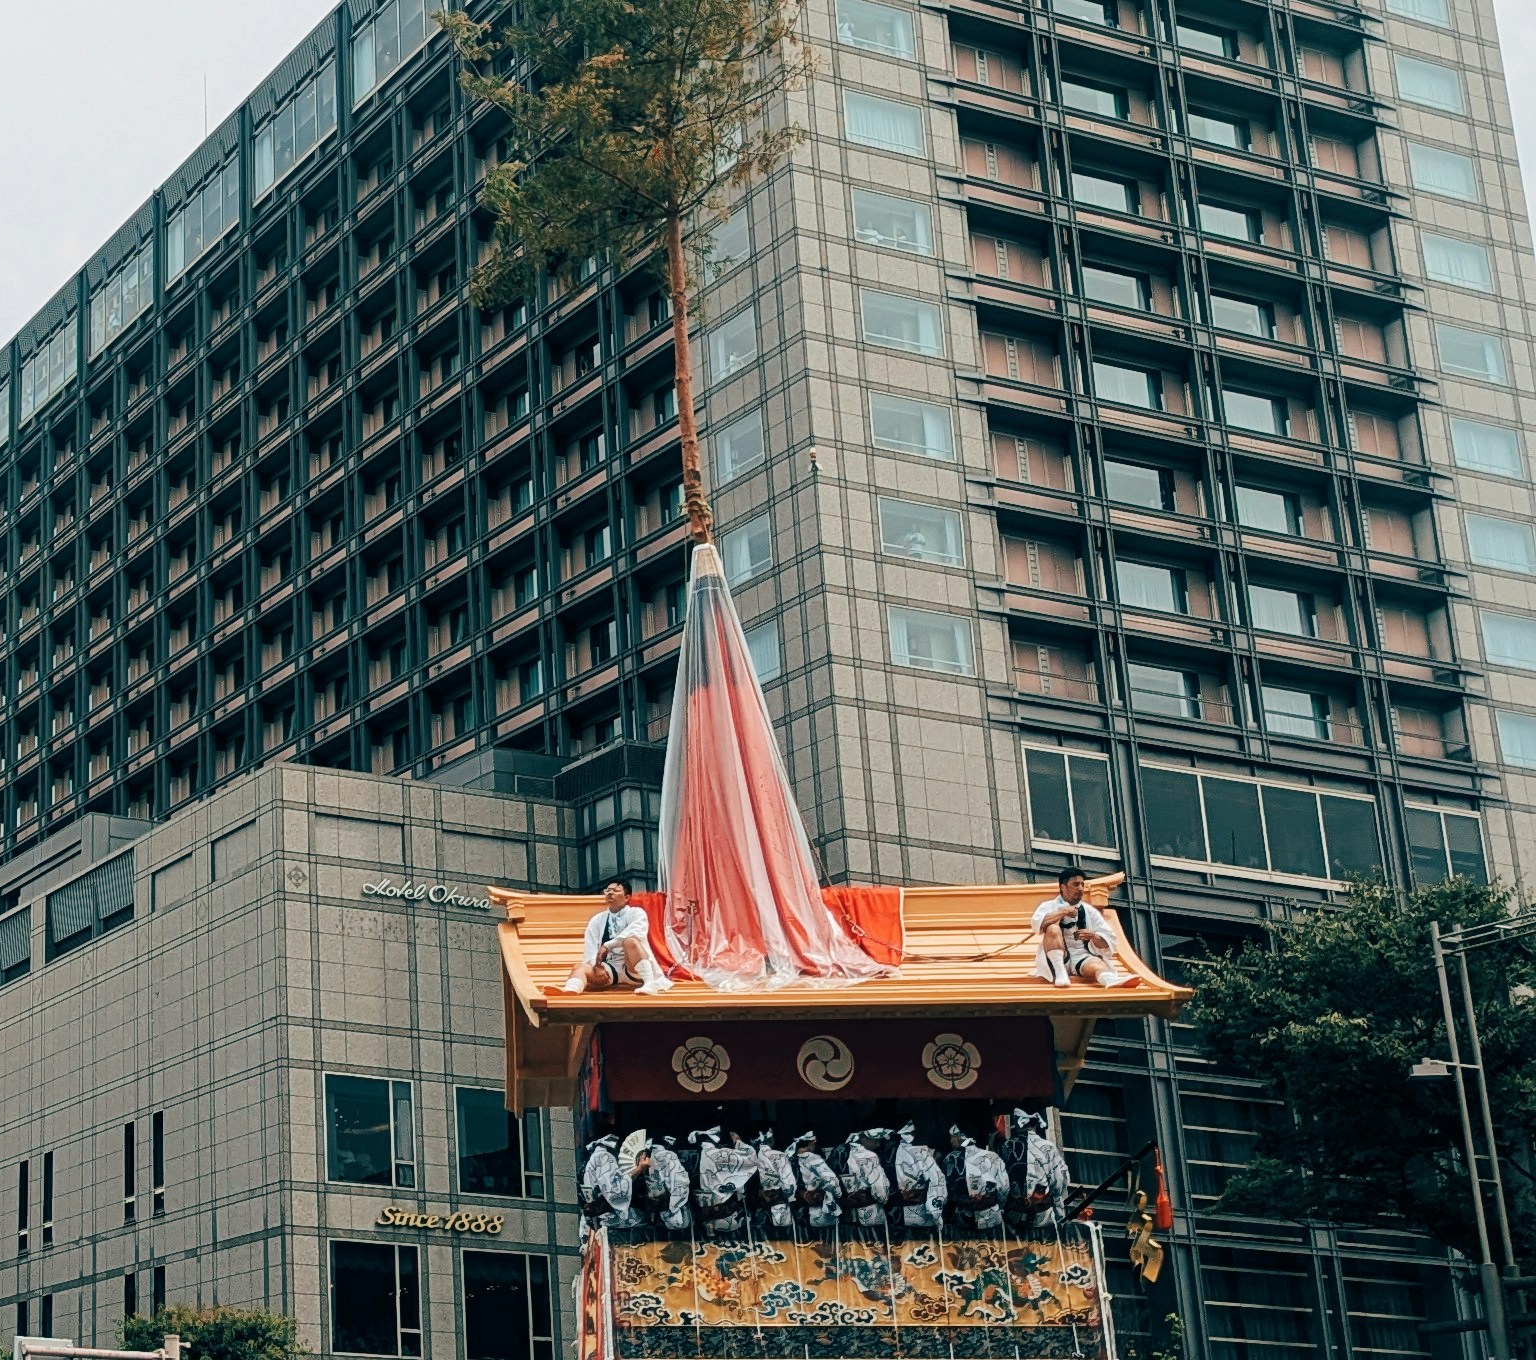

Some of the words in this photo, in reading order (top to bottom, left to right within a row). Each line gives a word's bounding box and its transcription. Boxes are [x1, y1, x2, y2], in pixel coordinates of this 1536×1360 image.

[362, 878, 427, 900] Hotel
[428, 884, 492, 910] Okura
[377, 1206, 440, 1229] Since
[444, 1211, 505, 1234] 1888
